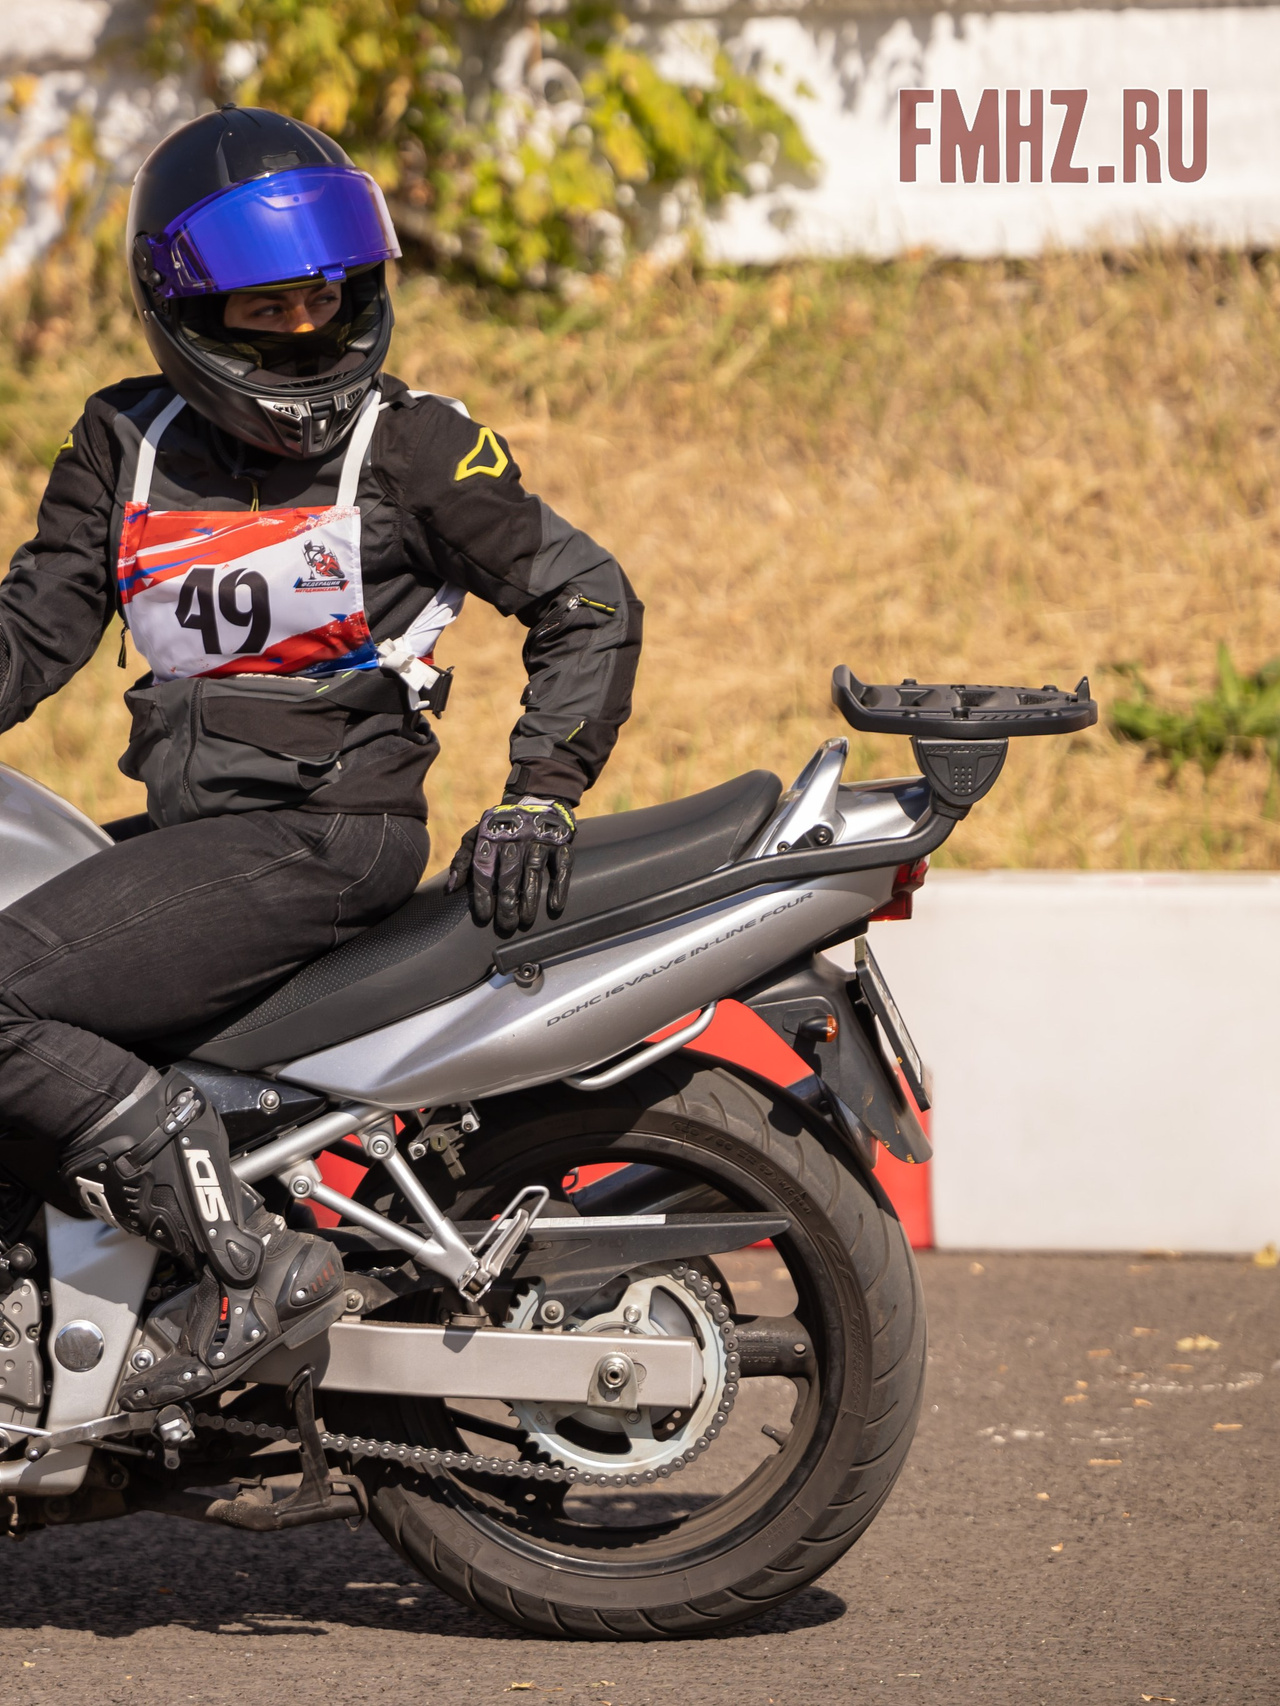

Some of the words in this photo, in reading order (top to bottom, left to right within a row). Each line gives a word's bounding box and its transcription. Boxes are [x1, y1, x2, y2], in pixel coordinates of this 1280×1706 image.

[175, 567, 271, 655] 49
[301, 580, 340, 588] ФЕДЕРАЦИЯ
[546, 994, 602, 1027] DOHC
[690, 918, 757, 958] IN-LINE
[759, 891, 814, 924] FOUR
